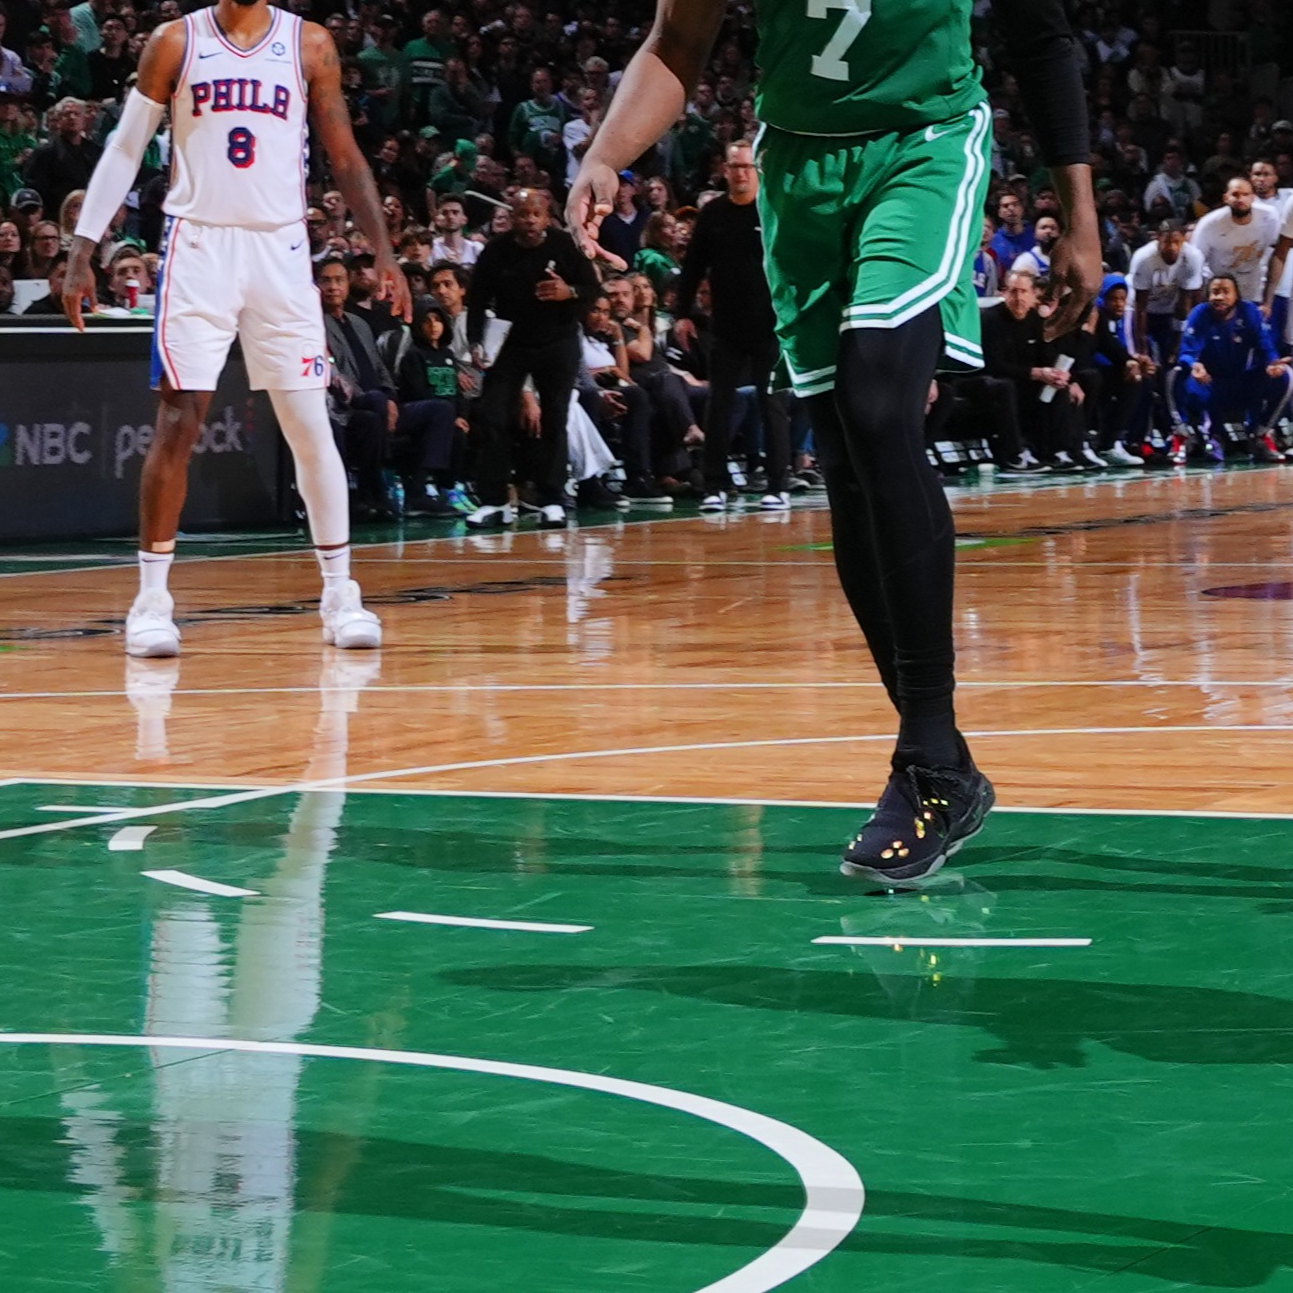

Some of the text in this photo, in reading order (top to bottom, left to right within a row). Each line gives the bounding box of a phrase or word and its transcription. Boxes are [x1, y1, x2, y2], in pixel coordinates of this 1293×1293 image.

[191, 78, 291, 120] PHILA
[227, 127, 256, 169] 8
[301, 356, 325, 378] 76
[14, 421, 93, 466] NBC
